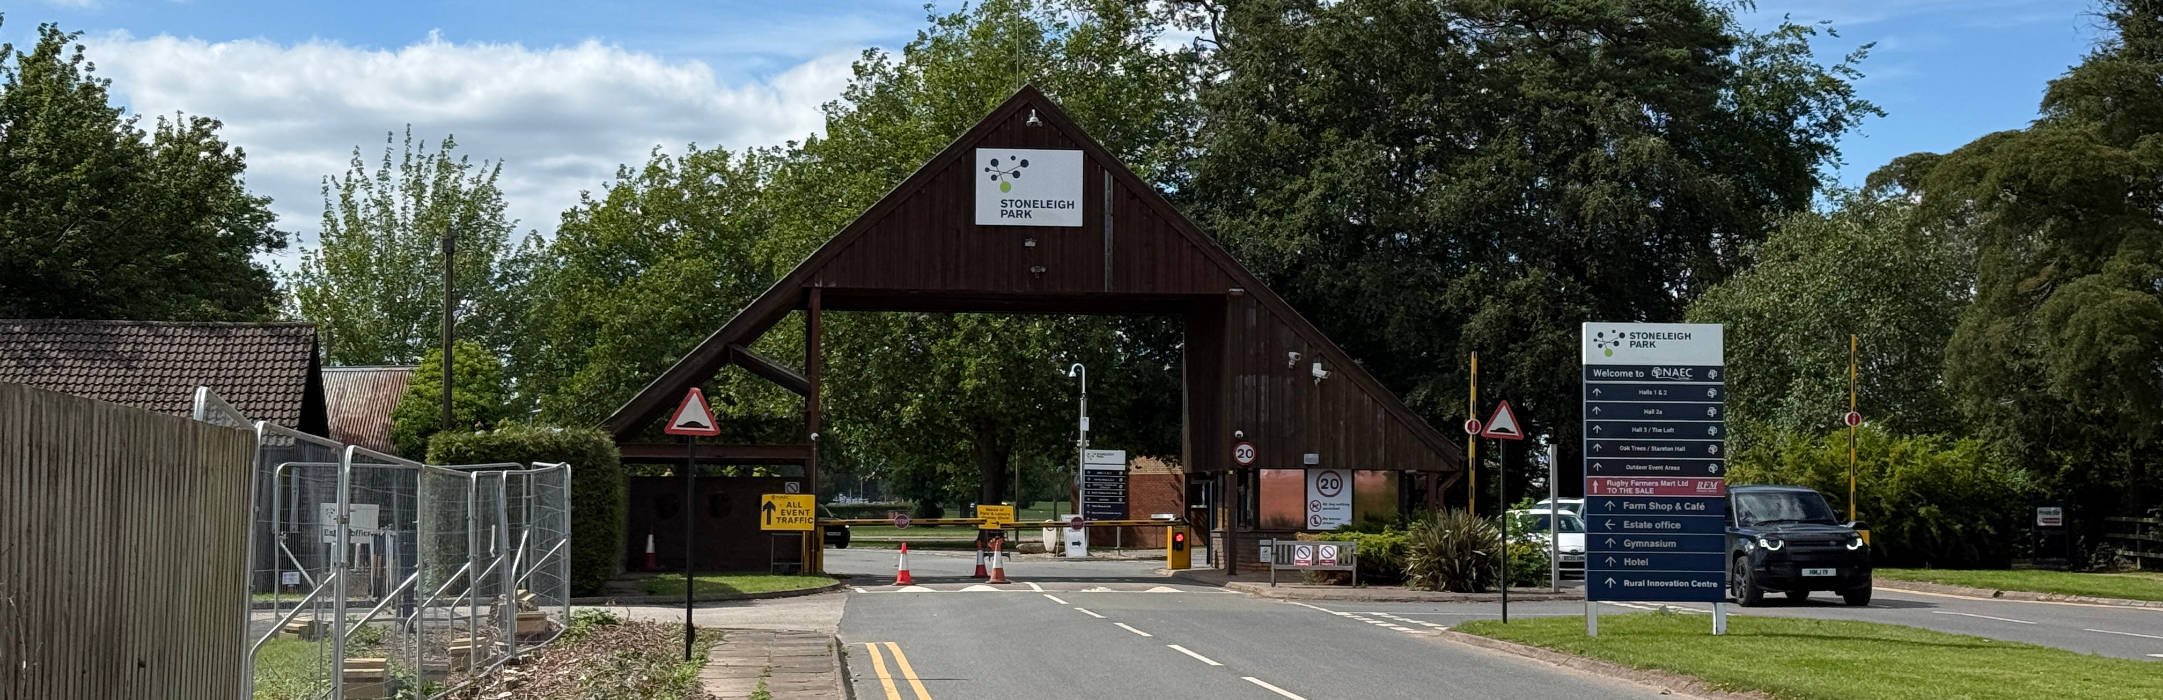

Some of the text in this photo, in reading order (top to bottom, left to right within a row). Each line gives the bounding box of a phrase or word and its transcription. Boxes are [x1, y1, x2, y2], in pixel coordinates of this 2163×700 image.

[1000, 199, 1075, 209] STONELEIGH
[1000, 209, 1032, 219] PARK
[1629, 332, 1692, 340] STONELEIGH
[1629, 340, 1657, 349] PARK
[1593, 367, 1694, 378] Welcome to NAEC
[1643, 408, 1655, 416] Hall
[1237, 448, 1254, 459] 20
[1320, 478, 1340, 490] 20
[1606, 480, 1629, 488] Rugby
[1606, 487, 1655, 495] TO THE SALE
[786, 501, 803, 509] ALL
[1623, 502, 1706, 512] Farm Shop & Café
[780, 509, 811, 517] EVENT
[776, 516, 814, 525] TRAFFIC
[1623, 520, 1682, 529] Estate office
[1623, 539, 1677, 550] Gymnasium
[1623, 557, 1649, 566] Hotel
[1623, 579, 1718, 588] Rural Innovation Centre
